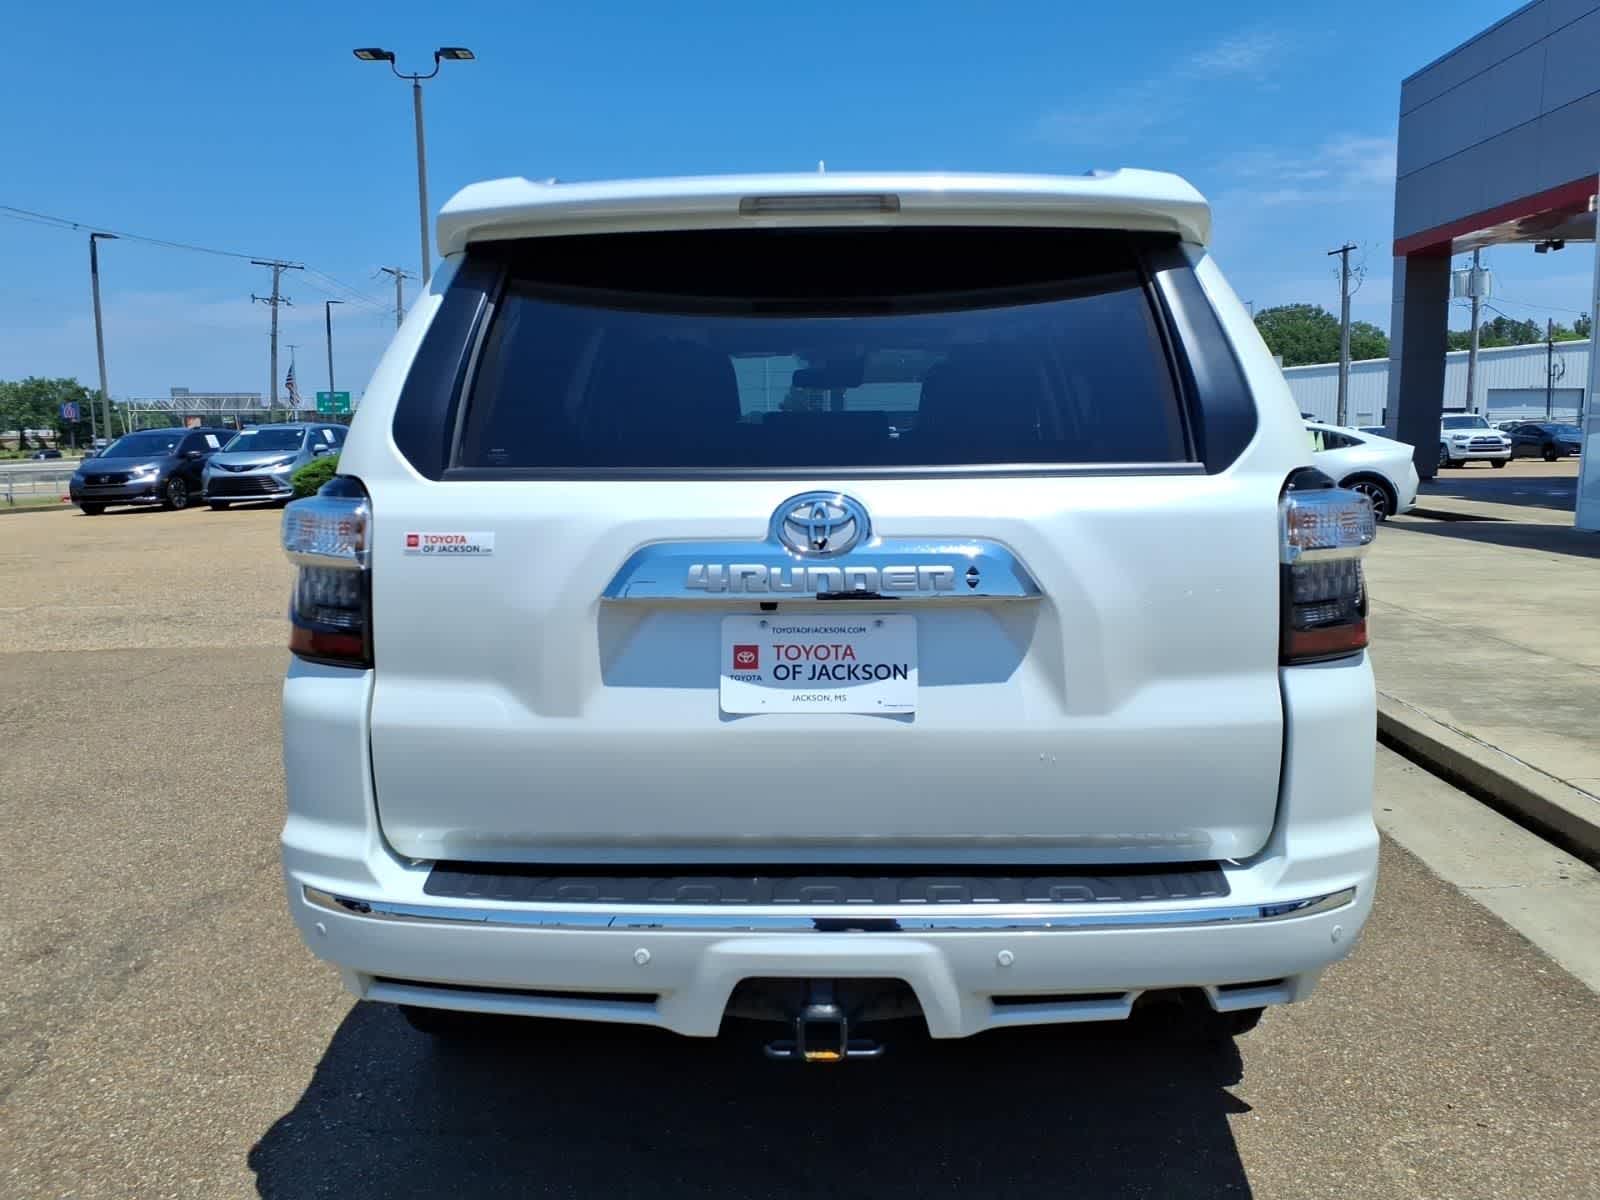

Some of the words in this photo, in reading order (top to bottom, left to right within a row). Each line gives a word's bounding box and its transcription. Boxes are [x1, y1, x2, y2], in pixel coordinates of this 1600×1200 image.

[424, 535, 467, 544] TOYOTA
[423, 545, 434, 553] OF
[687, 563, 956, 592] 4RUNNER
[772, 626, 867, 634] TOYOTAOFJACKSON.COM
[772, 644, 856, 661] TOYOTA
[773, 664, 803, 681] OF
[808, 664, 908, 681] JACKSON
[730, 674, 762, 682] TOYOTA
[792, 694, 832, 703] JACKSON,
[834, 694, 847, 702] MS
